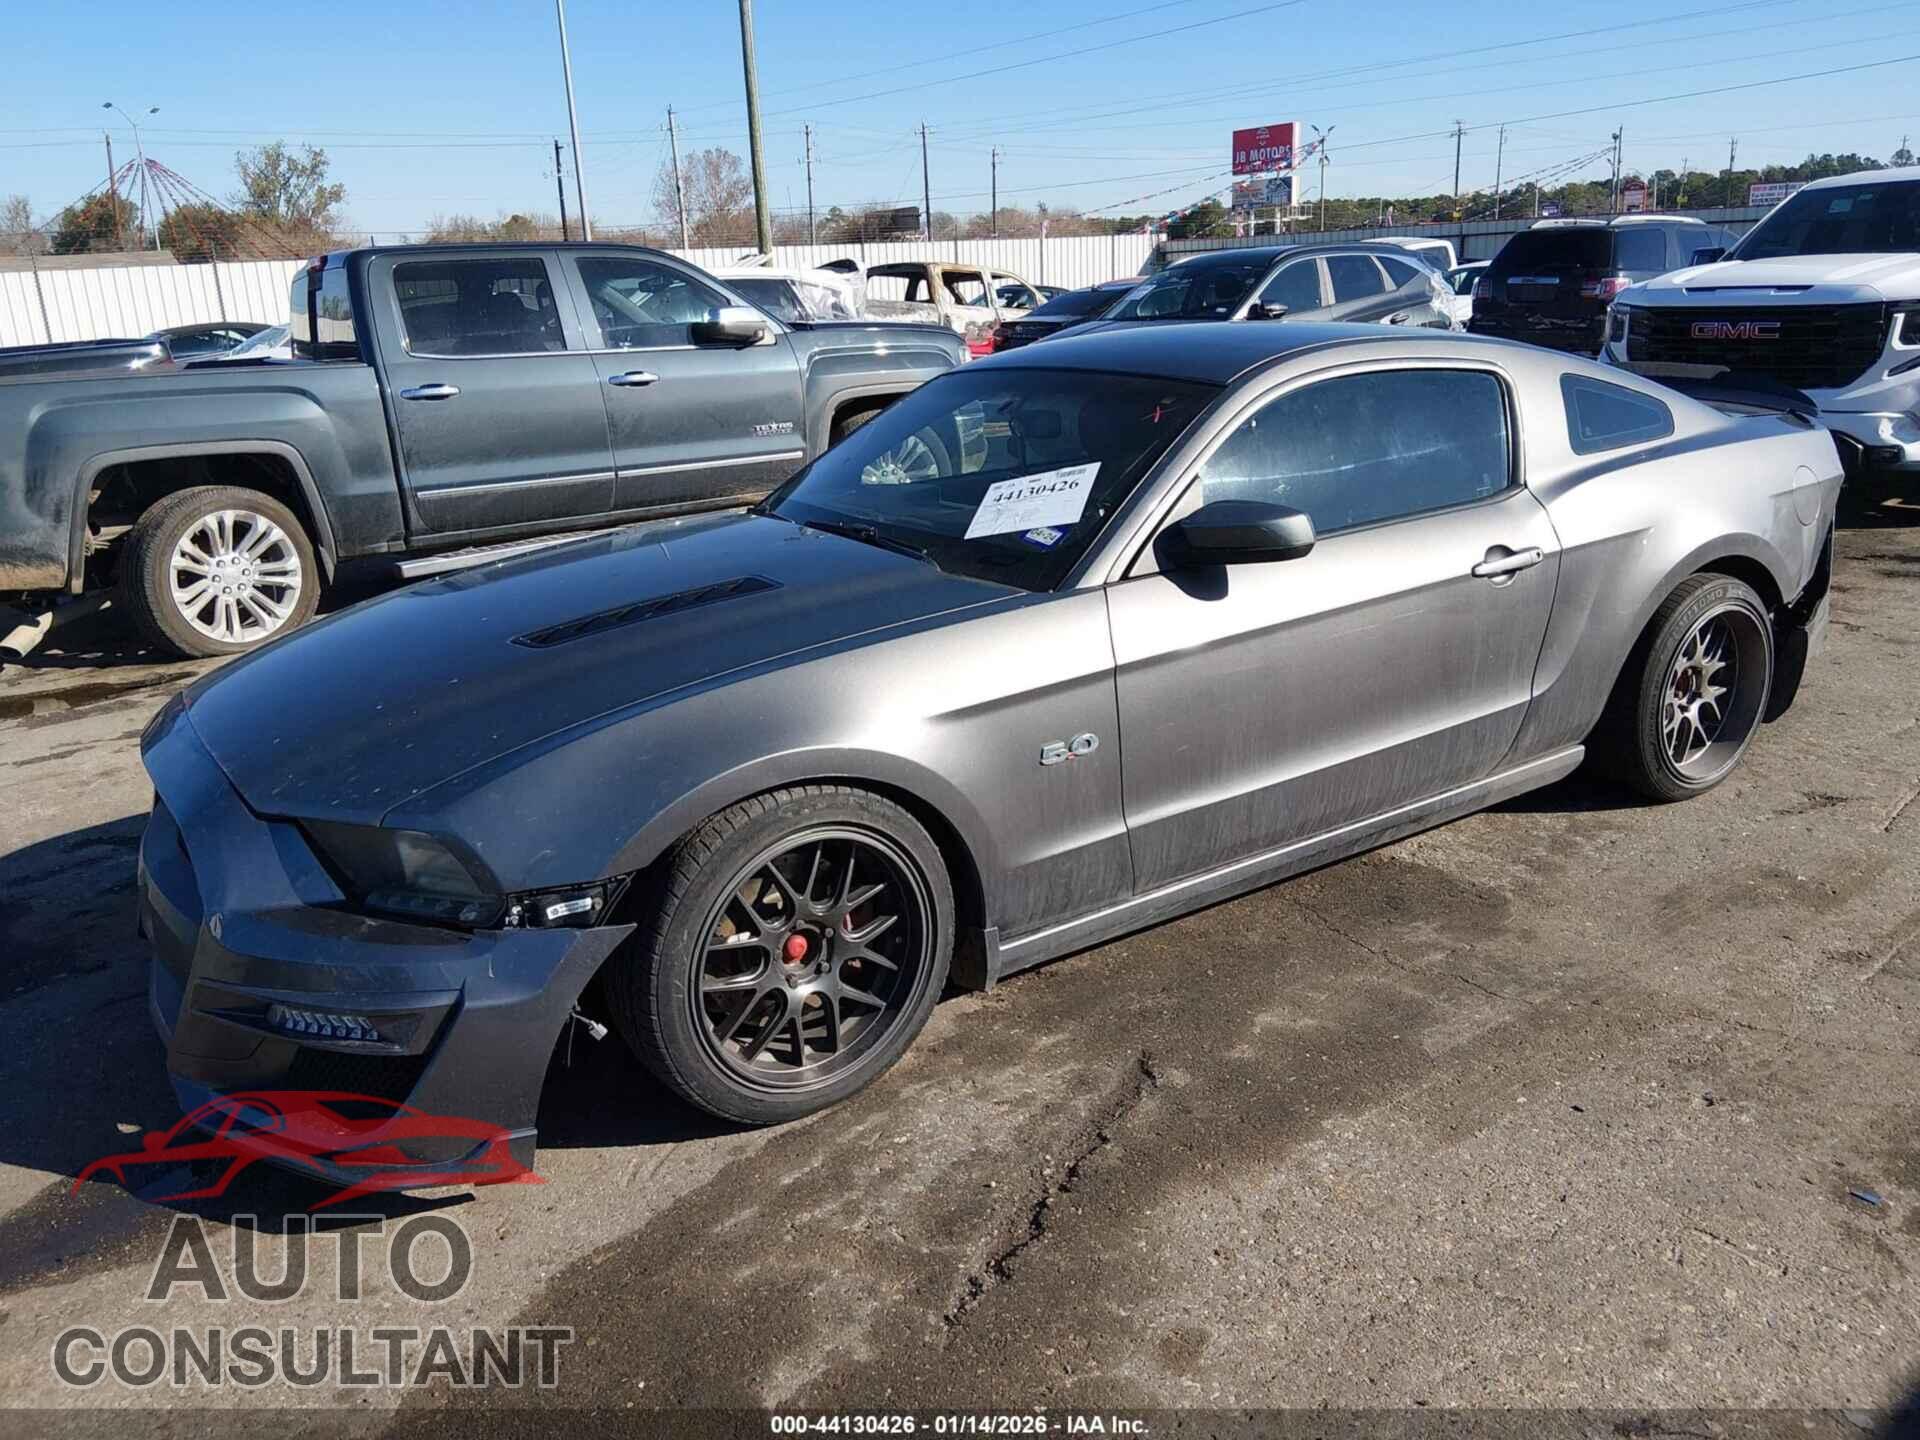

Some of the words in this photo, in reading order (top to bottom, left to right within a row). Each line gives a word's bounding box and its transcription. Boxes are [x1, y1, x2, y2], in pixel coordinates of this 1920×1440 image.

[1691, 321, 1781, 339] GMC
[993, 479, 1080, 503] 44130426
[1040, 733, 1099, 766] 5.0
